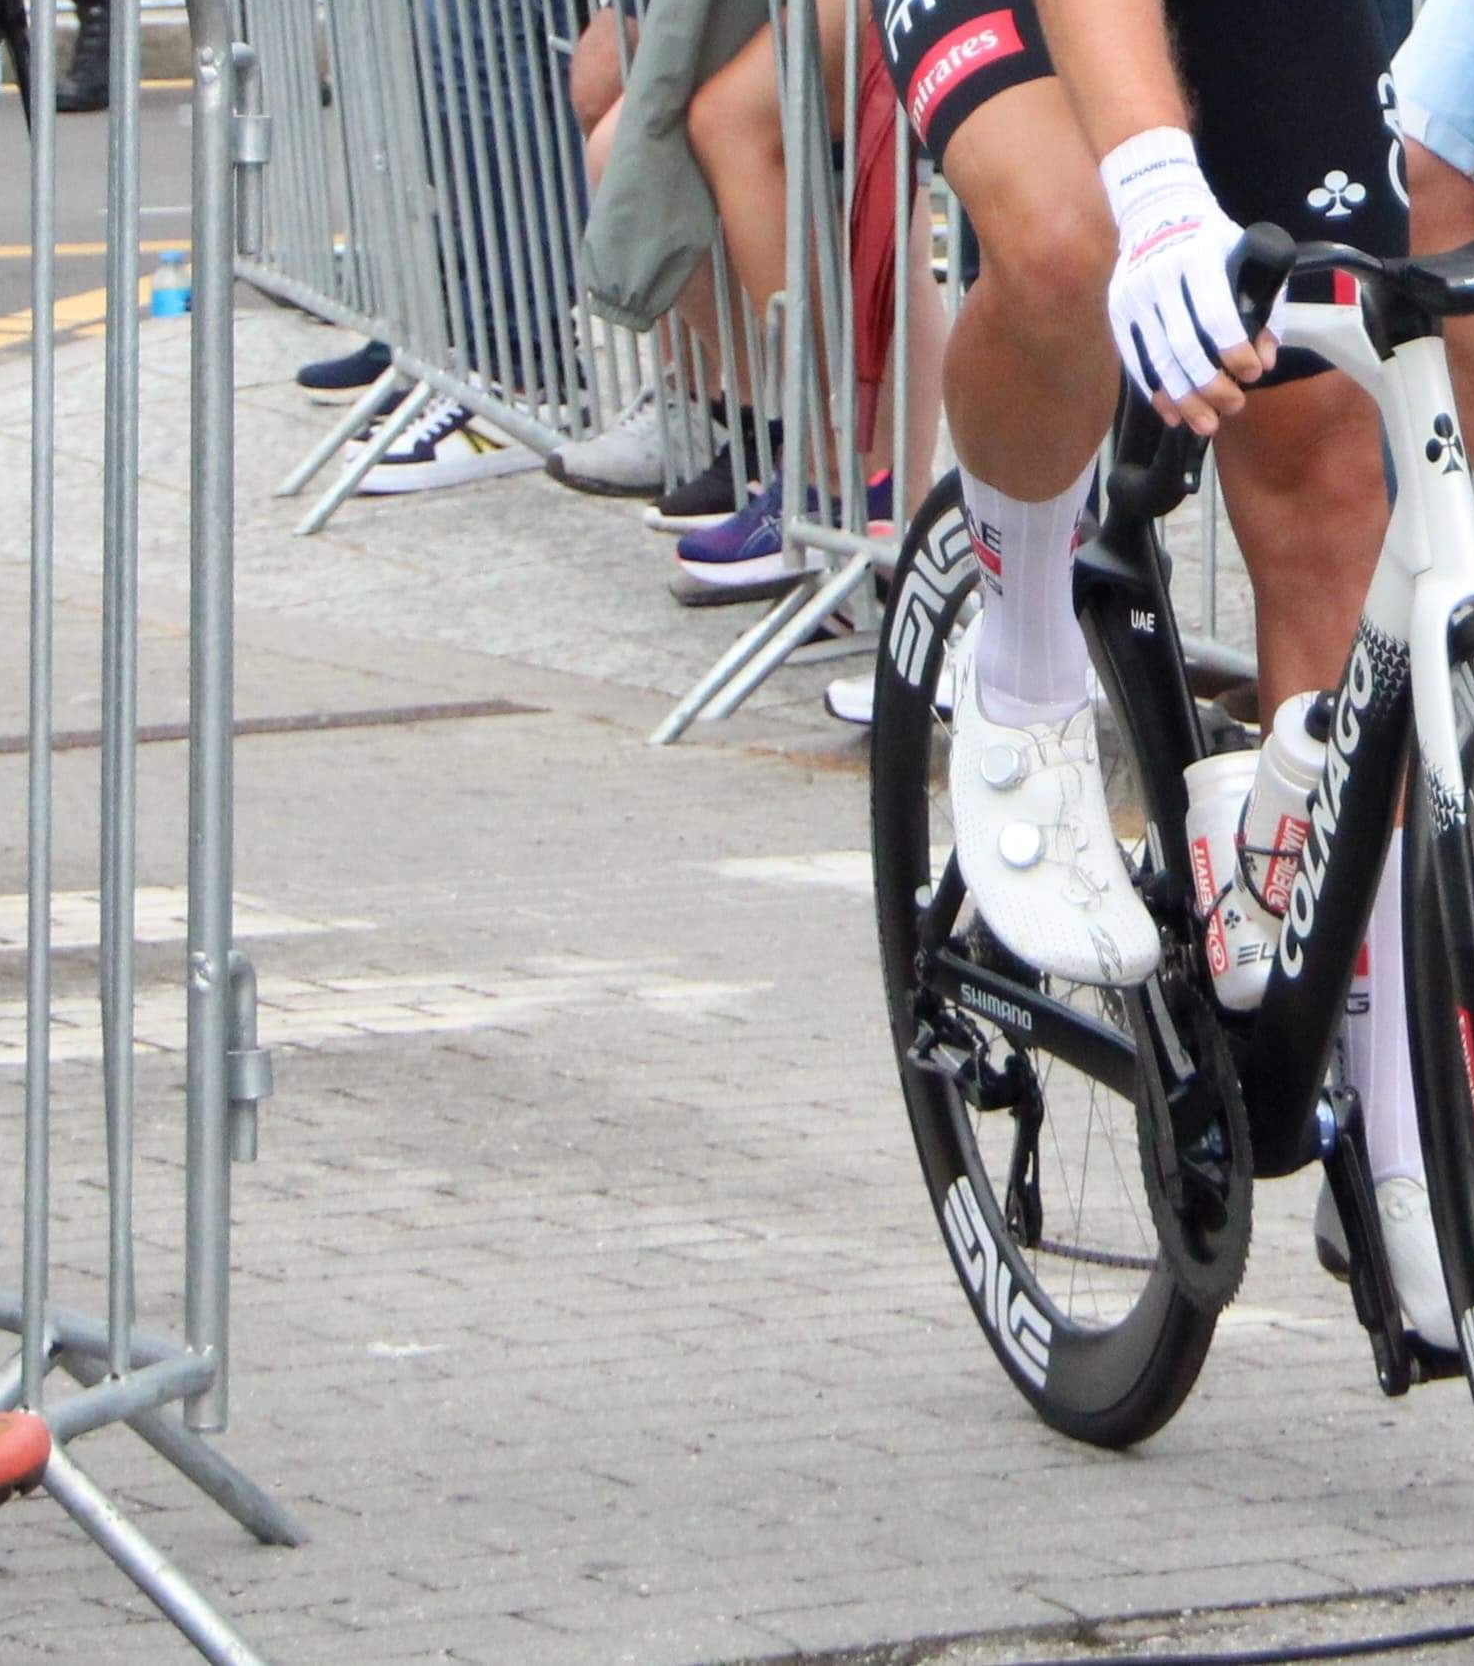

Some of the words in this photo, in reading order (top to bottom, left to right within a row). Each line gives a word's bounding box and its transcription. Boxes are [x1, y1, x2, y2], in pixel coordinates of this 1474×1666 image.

[1130, 608, 1156, 632] UAE
[1280, 643, 1373, 979] COLNAGO
[960, 982, 1033, 1032] SHIMANO
